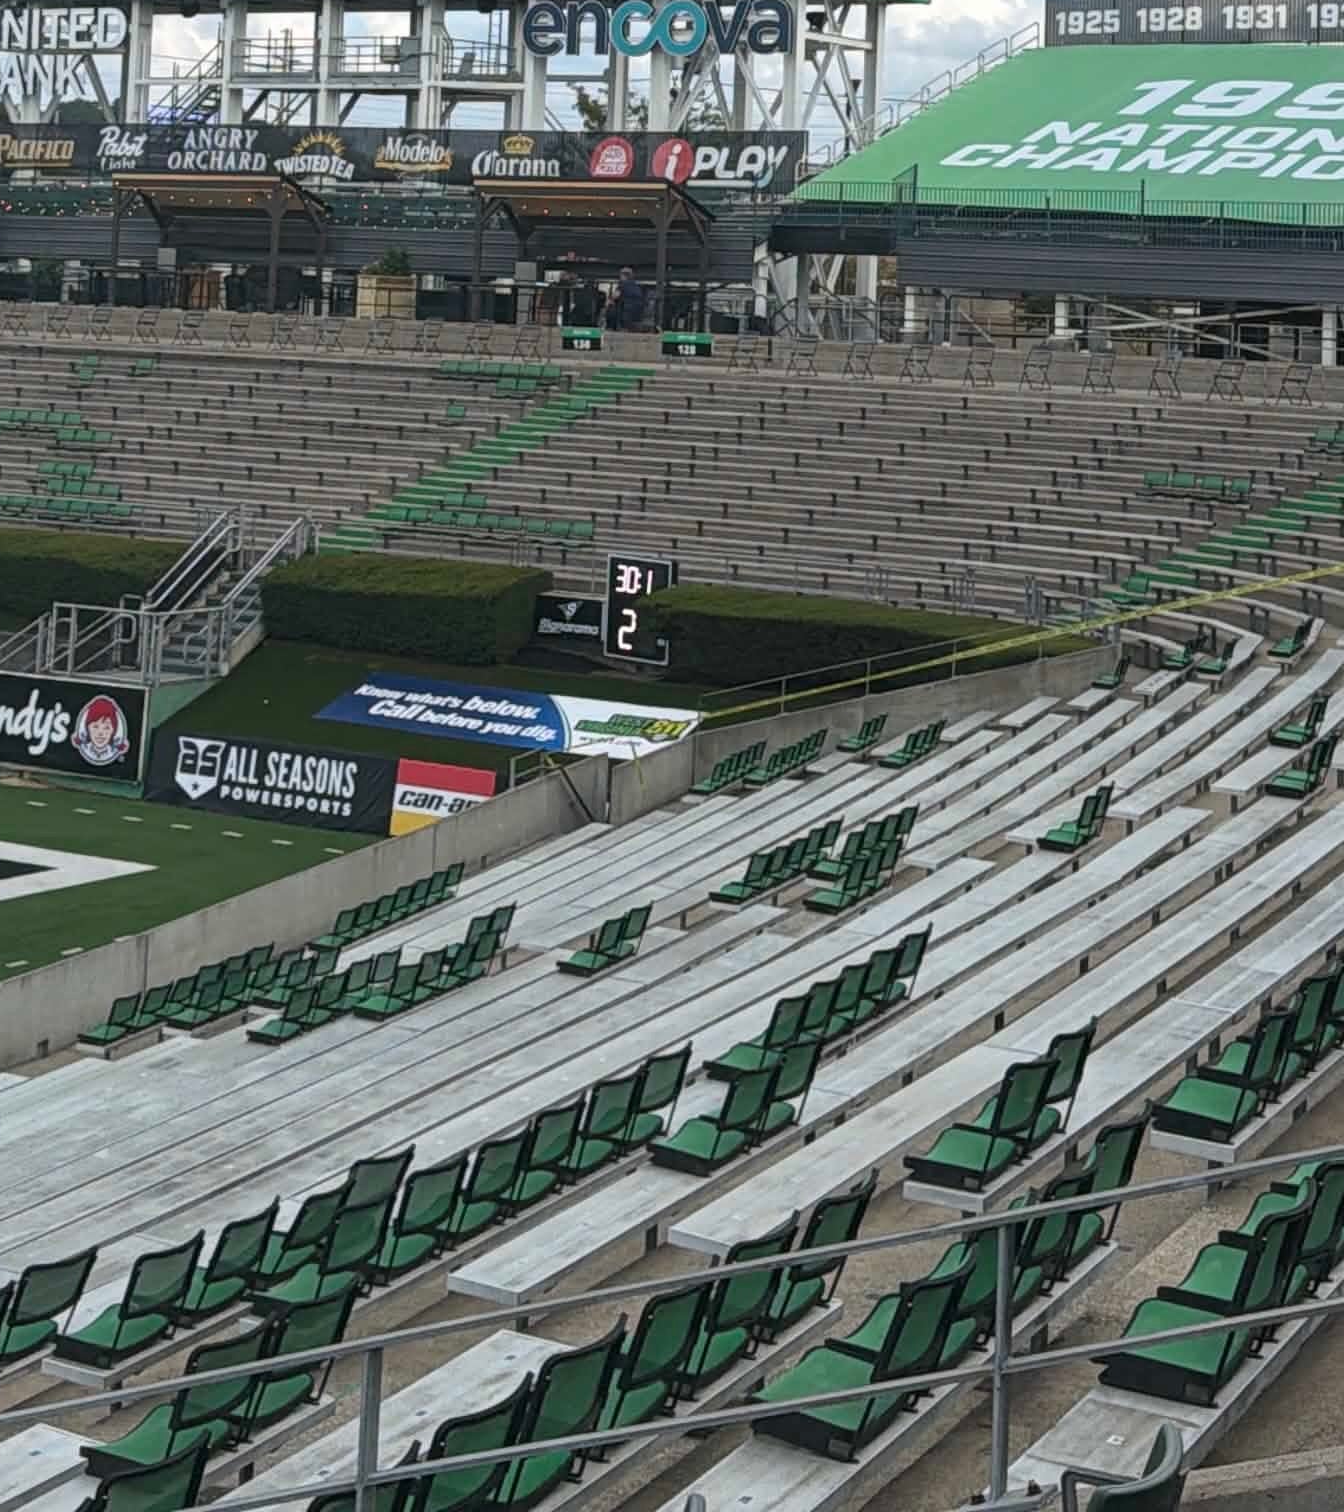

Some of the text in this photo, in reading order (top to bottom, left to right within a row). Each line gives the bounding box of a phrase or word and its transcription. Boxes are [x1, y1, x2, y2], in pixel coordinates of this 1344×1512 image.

[1056, 8, 1120, 35] 1925
[1136, 5, 1203, 33] 1928
[1222, 3, 1287, 30] 1931
[96, 126, 148, 157] Pabst
[184, 128, 259, 150] ANGRY
[383, 136, 445, 163] Modelo
[167, 151, 267, 172] ORCHARD
[273, 154, 355, 180] TWISTED TEA
[471, 149, 560, 177] Corona
[617, 608, 638, 651] 2
[354, 683, 539, 720] Know what's below.
[367, 698, 416, 721] Call
[416, 709, 479, 733] before
[478, 719, 520, 738] you
[223, 742, 358, 799] ALL SEASONS
[219, 784, 354, 818] POWERSPORTS
